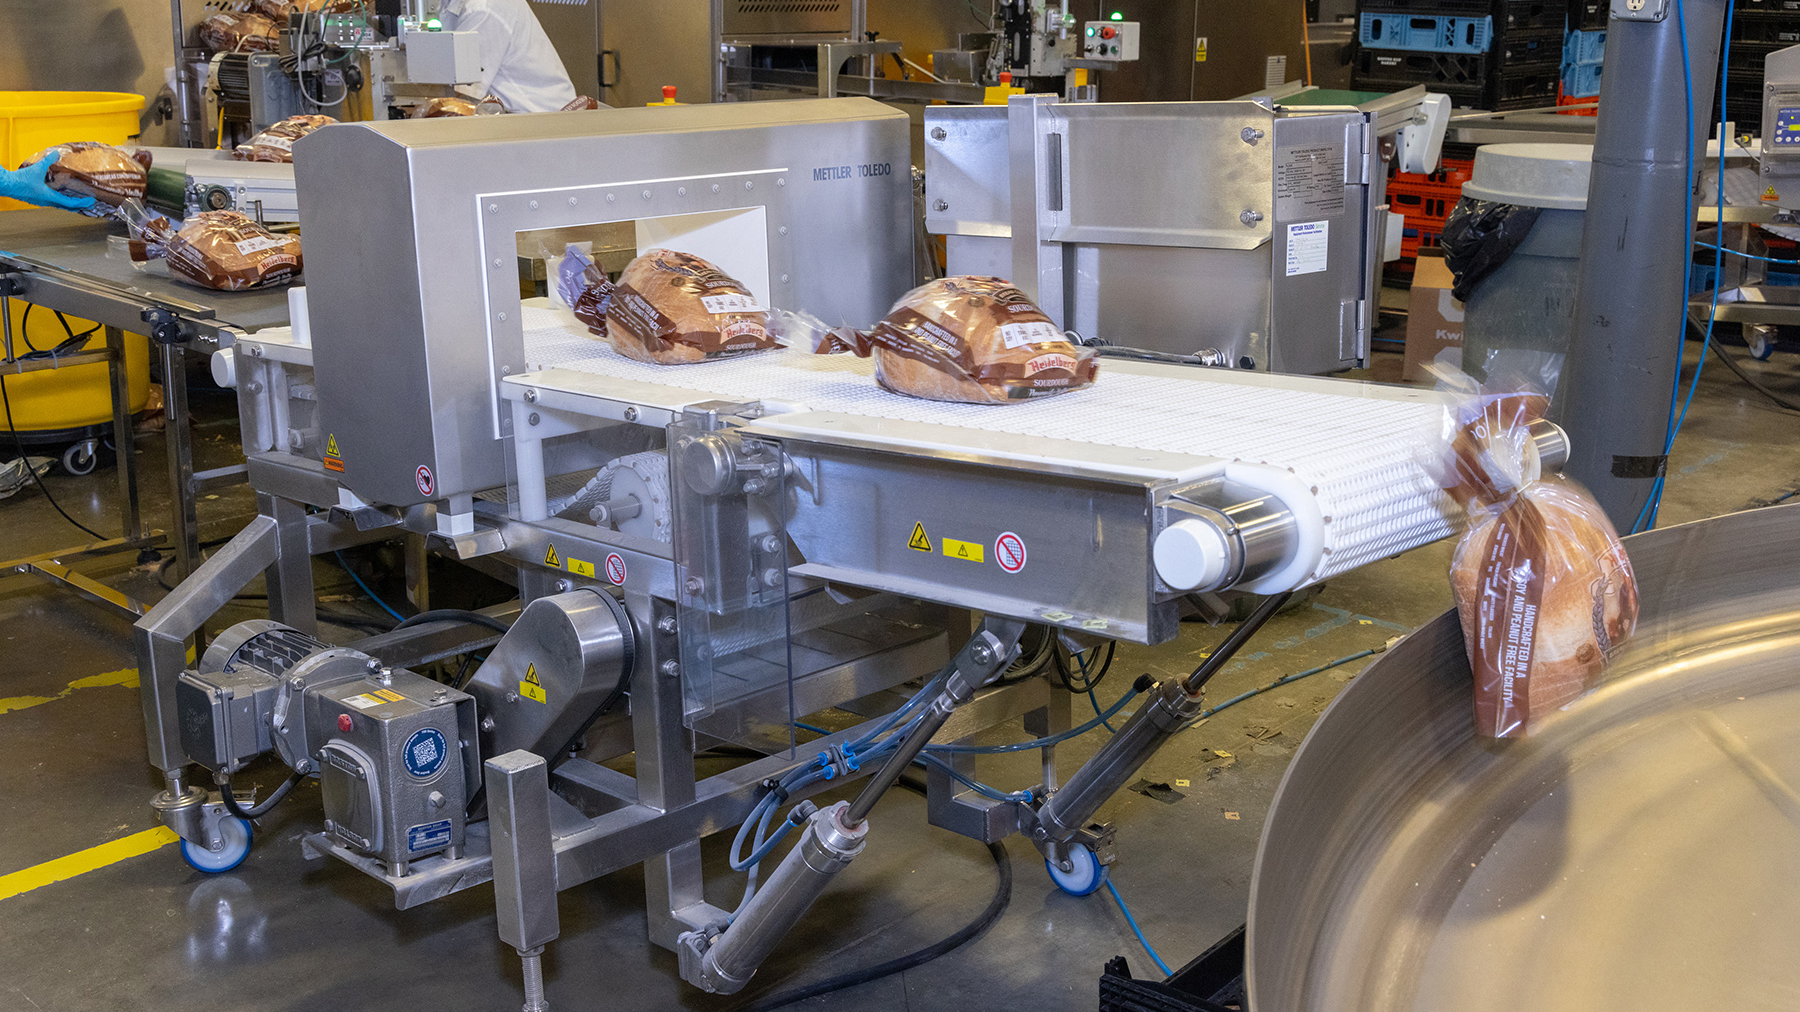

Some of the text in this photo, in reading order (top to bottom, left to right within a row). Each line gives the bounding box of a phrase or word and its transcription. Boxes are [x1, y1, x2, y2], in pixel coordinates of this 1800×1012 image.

[813, 162, 891, 181] METTLER TOLEDO
[1027, 356, 1077, 372] Heidelberg
[1512, 594, 1525, 612] AND
[1508, 613, 1523, 644] PEANUT
[1518, 604, 1537, 662] HANDCRAFTED
[1505, 644, 1518, 666] FREE
[1516, 662, 1528, 671] IN
[1502, 666, 1515, 702] FACILITY
